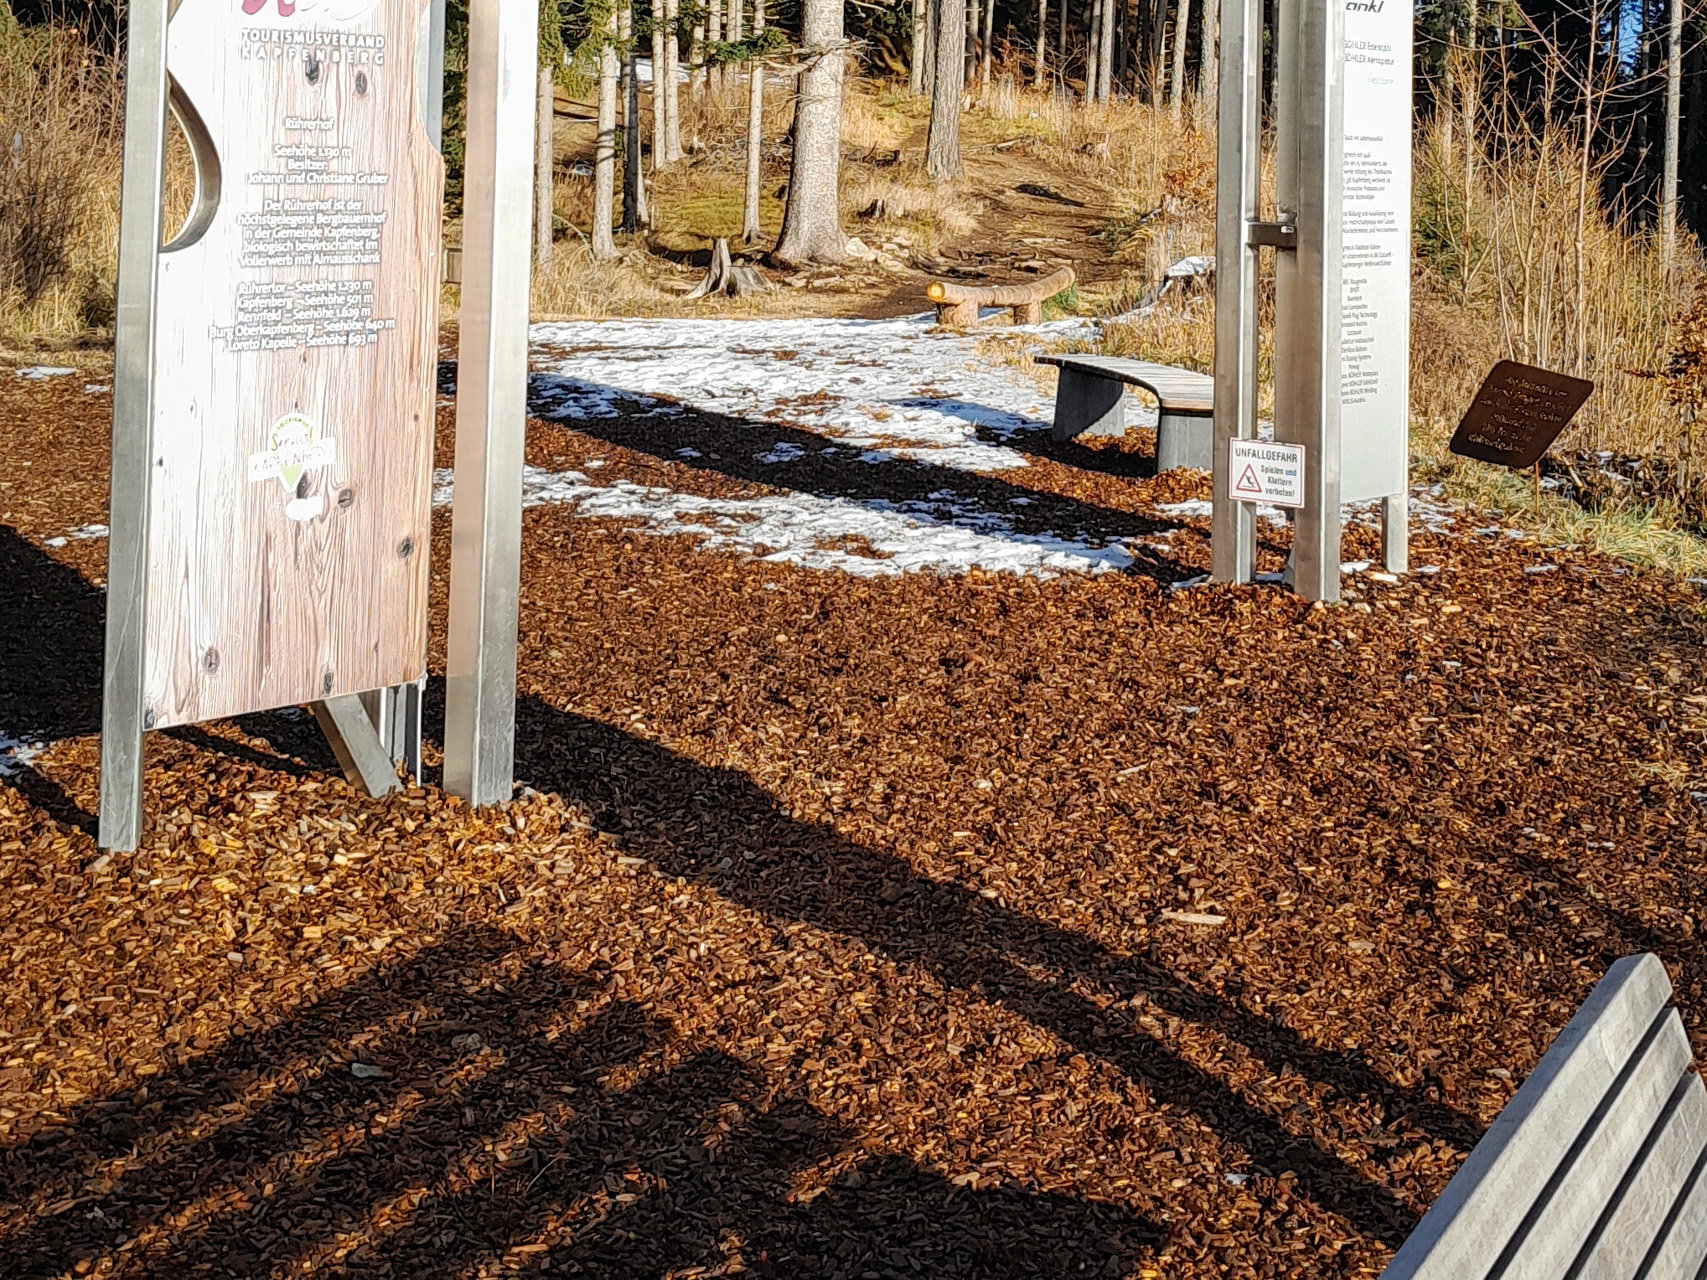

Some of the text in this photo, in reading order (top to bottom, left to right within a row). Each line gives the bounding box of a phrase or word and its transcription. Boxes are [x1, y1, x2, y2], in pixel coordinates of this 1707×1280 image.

[1345, 0, 1384, 13] ankl
[241, 28, 385, 48] TOURISMUSVERBAND
[240, 46, 385, 65] KAPFENBERG
[285, 116, 335, 130] Rührerhof
[274, 144, 316, 157] Seehöhe
[342, 147, 352, 157] m
[287, 159, 329, 170] Besitzer:
[248, 172, 389, 184] Johann und Christiane Gruber
[264, 200, 282, 212] Der
[284, 199, 333, 211] Rührerhof
[346, 199, 363, 210] der
[237, 212, 387, 228] höchstgelegene Bergbauernhof
[254, 226, 273, 238] der
[273, 227, 322, 238] Gemeinde
[244, 239, 378, 254] biologisch bewirtschaftet im
[294, 254, 312, 265] mit
[313, 252, 381, 266] Almausschank
[295, 281, 337, 293] Seehöhe
[363, 282, 372, 291] m
[237, 296, 294, 310] Kapfenberg
[304, 293, 346, 306] Seehöhe
[363, 294, 374, 303] m
[237, 309, 282, 322] Rennfeld
[293, 308, 334, 320] Seehöhe
[361, 308, 372, 318] m
[235, 323, 315, 339] Oberkapfenberg
[323, 320, 365, 333] Seehöhe
[385, 320, 395, 329] m
[228, 338, 260, 352] Loreto
[261, 336, 298, 350] Kapelle
[306, 333, 348, 346] Seehöhe
[366, 333, 377, 343] m
[1235, 447, 1298, 463] UNFALLGEFAHR
[1261, 465, 1297, 477] Spielen und
